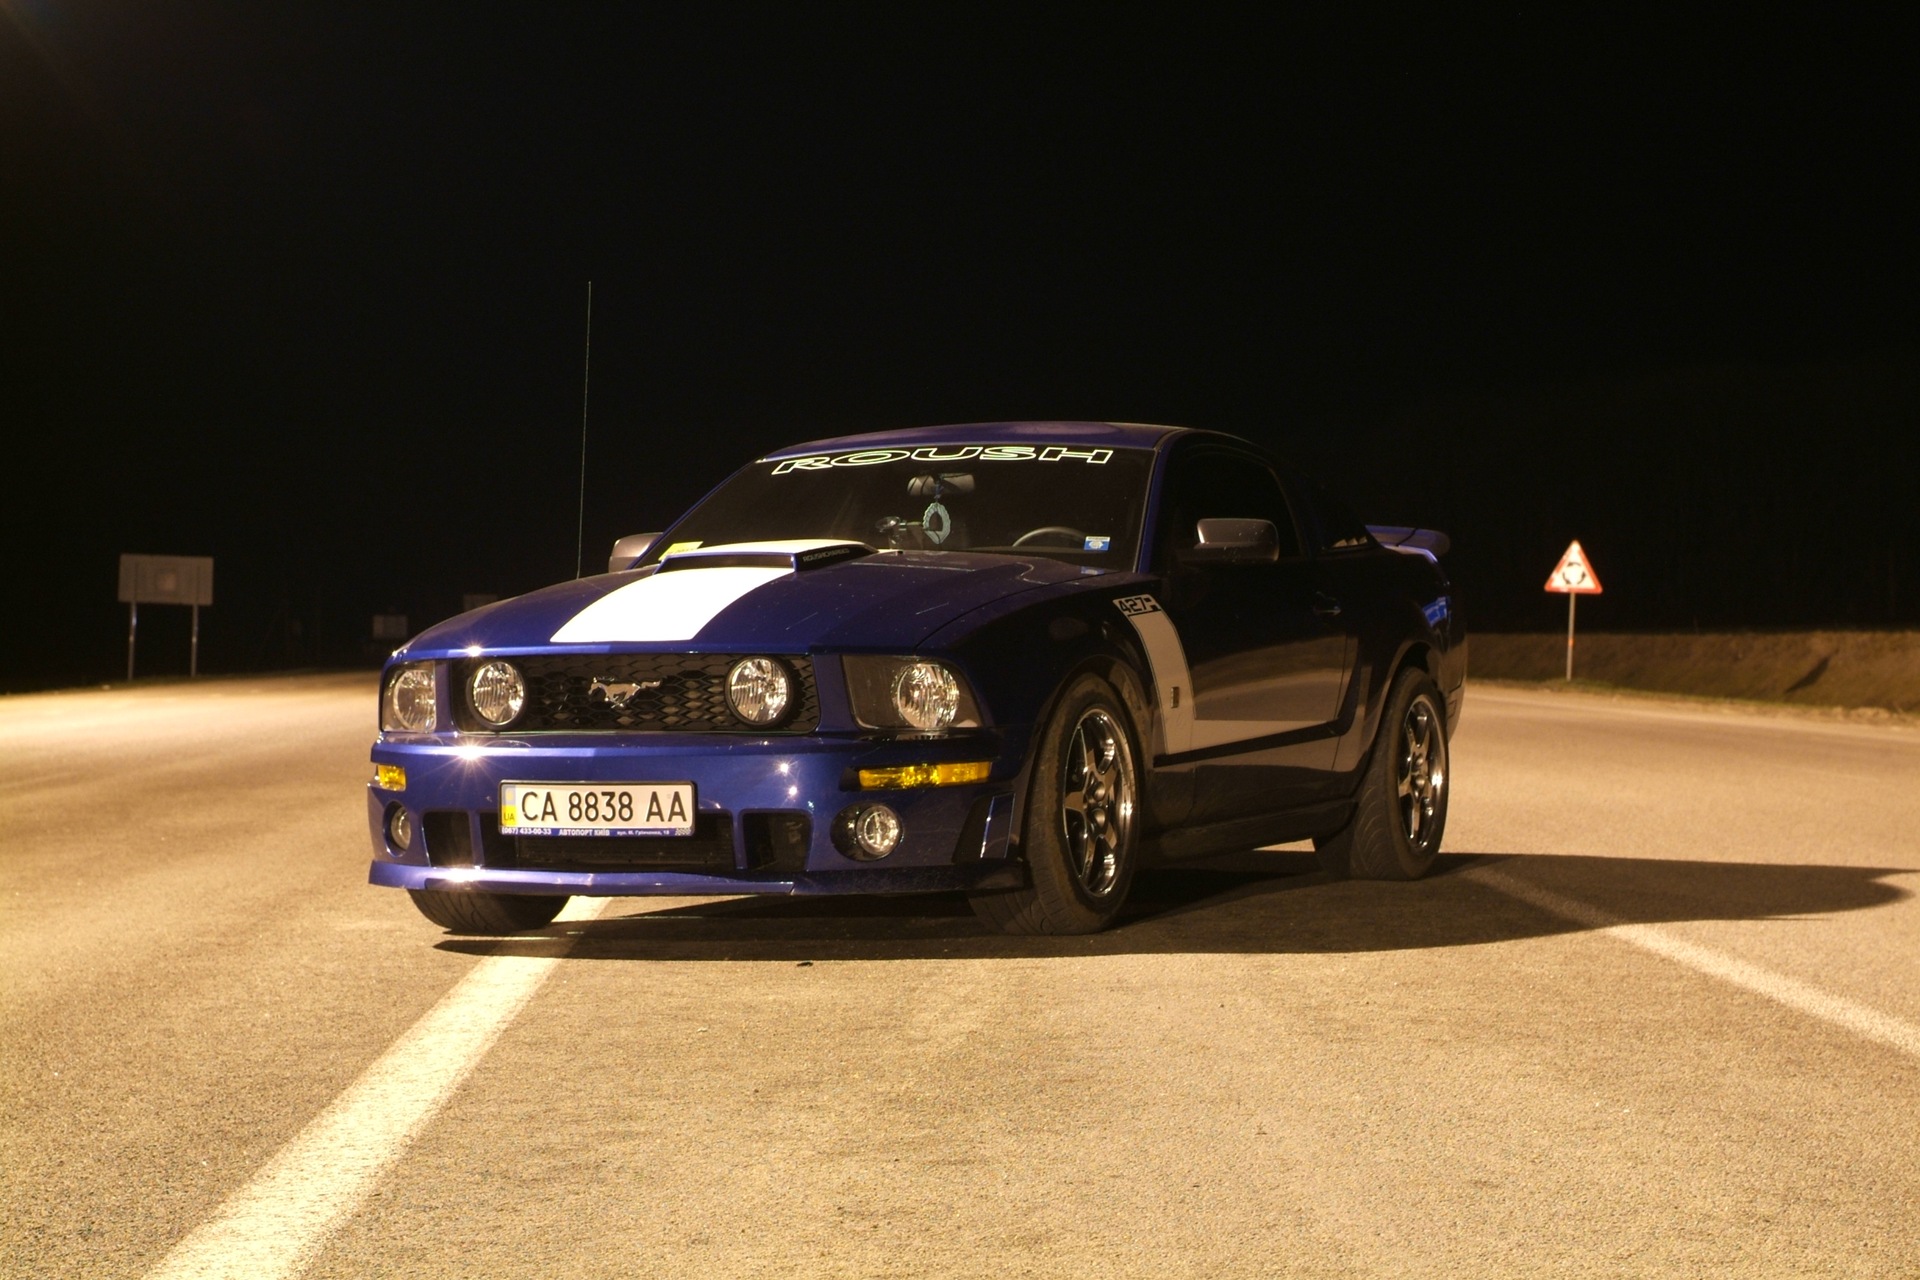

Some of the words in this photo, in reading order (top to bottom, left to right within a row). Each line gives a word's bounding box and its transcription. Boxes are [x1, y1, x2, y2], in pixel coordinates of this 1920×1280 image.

[771, 446, 1114, 476] ROUSH
[503, 812, 515, 821] UA
[521, 791, 558, 822] CA
[568, 791, 634, 822] 8838
[645, 791, 687, 822] AA
